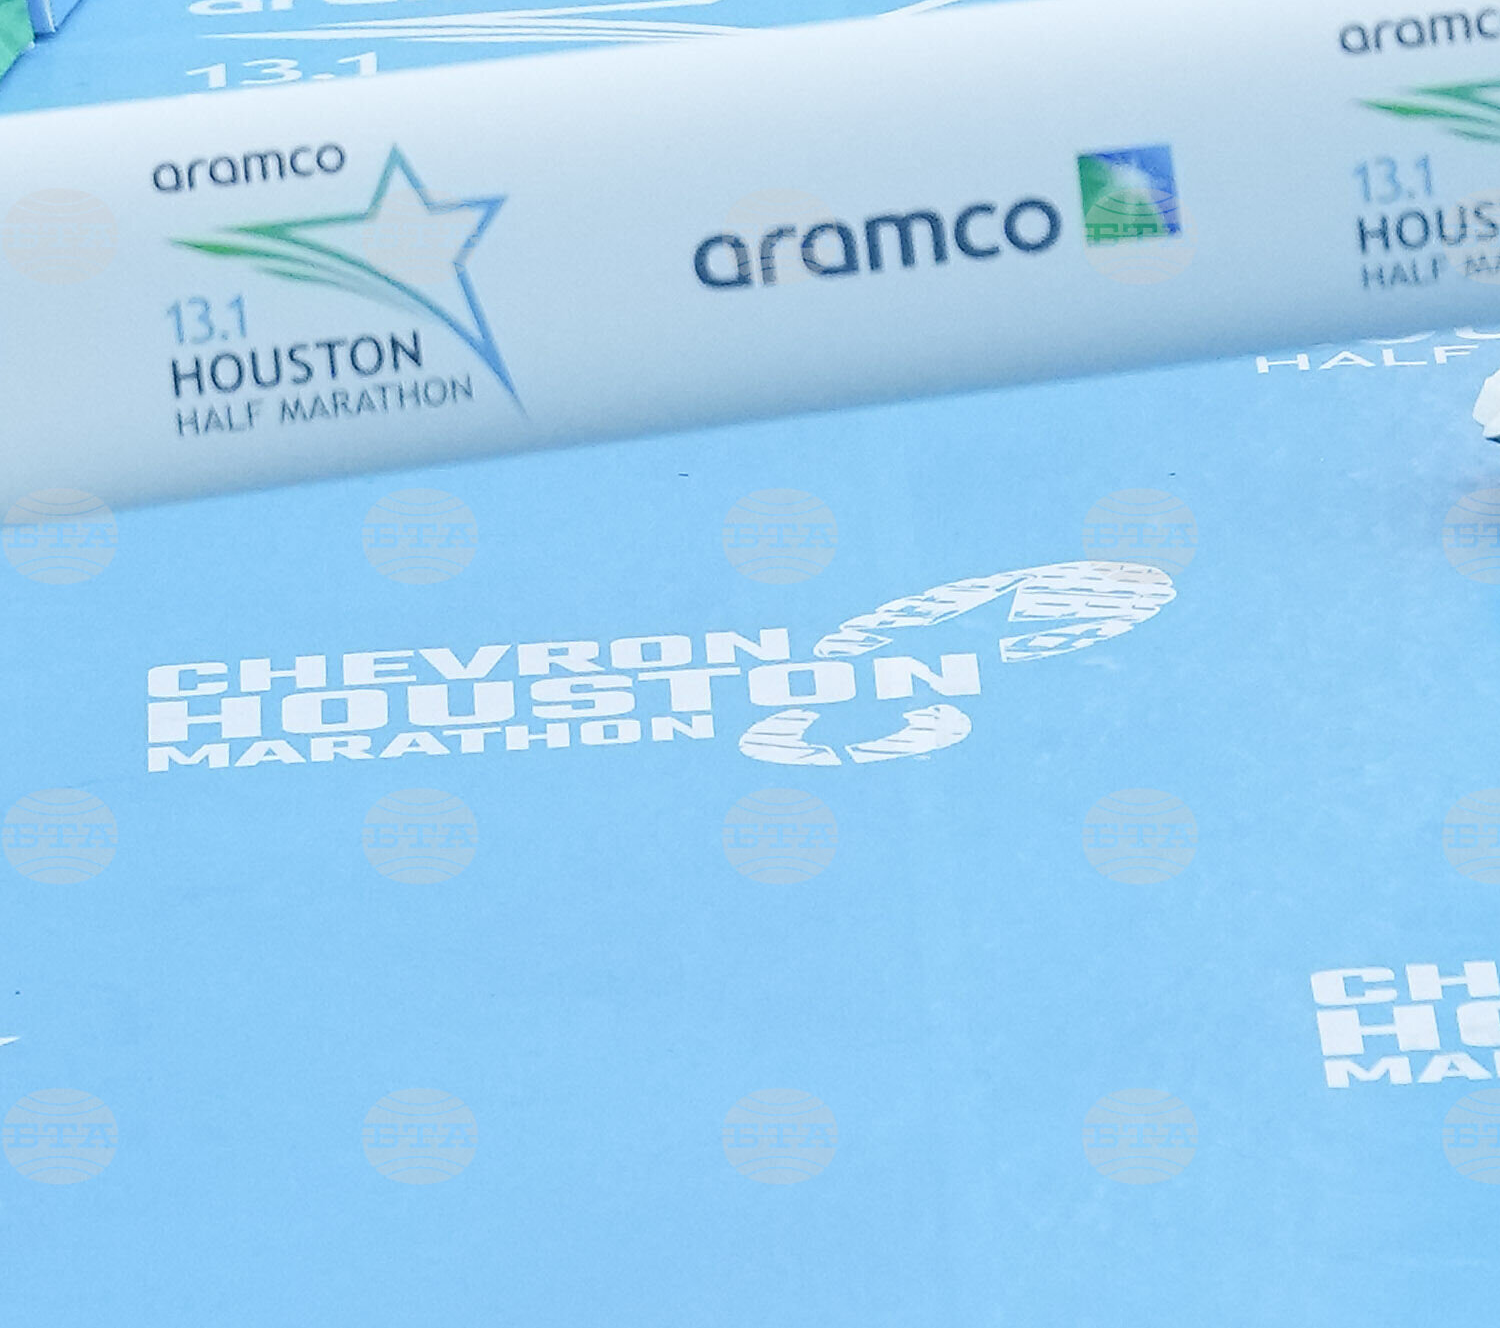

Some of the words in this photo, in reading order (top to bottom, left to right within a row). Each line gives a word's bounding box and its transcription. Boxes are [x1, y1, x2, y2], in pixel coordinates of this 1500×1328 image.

[185, 51, 379, 89] 13.1
[153, 143, 346, 191] aramco
[1354, 153, 1432, 203] 13.1
[693, 196, 1064, 291] aramco
[1361, 252, 1446, 288] HALF
[165, 293, 248, 345] 13.1
[170, 329, 423, 399] HOUSTON
[1256, 345, 1479, 373] HALF
[175, 399, 263, 436] HALF
[280, 374, 474, 426] MARATHON
[148, 627, 791, 698] CHEVRON
[148, 653, 981, 743] HOUSTON
[148, 714, 715, 773] MARATHON
